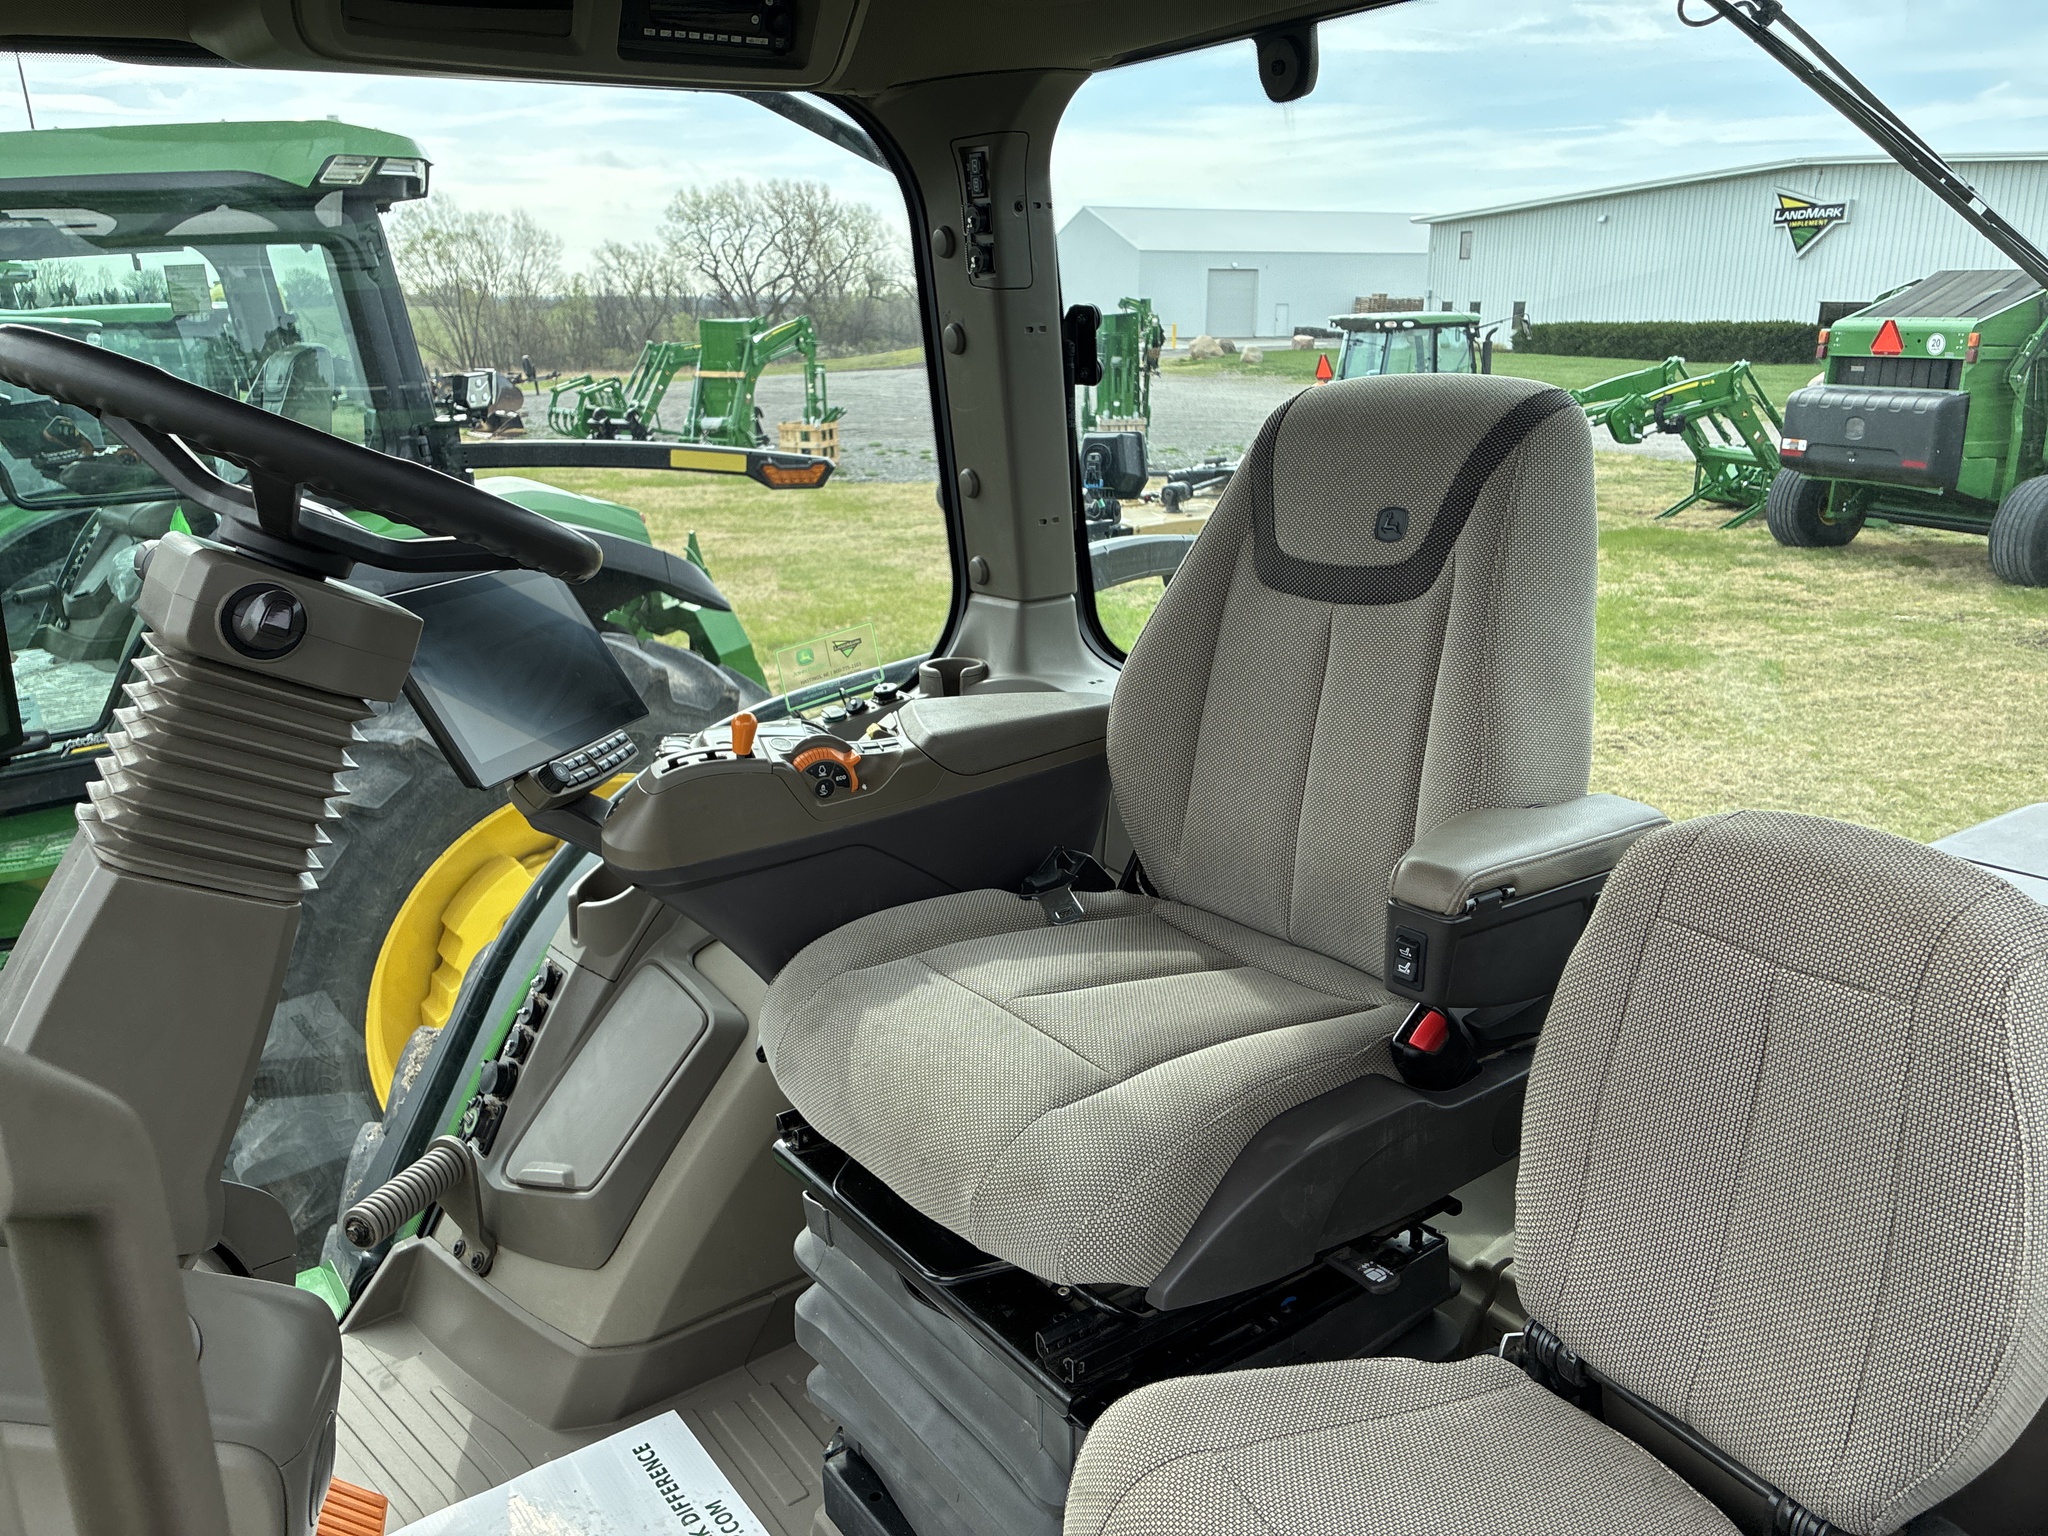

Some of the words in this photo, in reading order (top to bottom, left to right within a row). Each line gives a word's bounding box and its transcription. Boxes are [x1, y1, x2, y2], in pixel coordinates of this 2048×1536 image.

[1775, 207, 1843, 221] LANDMARK
[1789, 218, 1829, 228] IMPLEMENT
[1931, 338, 1941, 348] 20
[835, 774, 847, 782] ECO
[632, 1442, 701, 1527] DIFFERENCE
